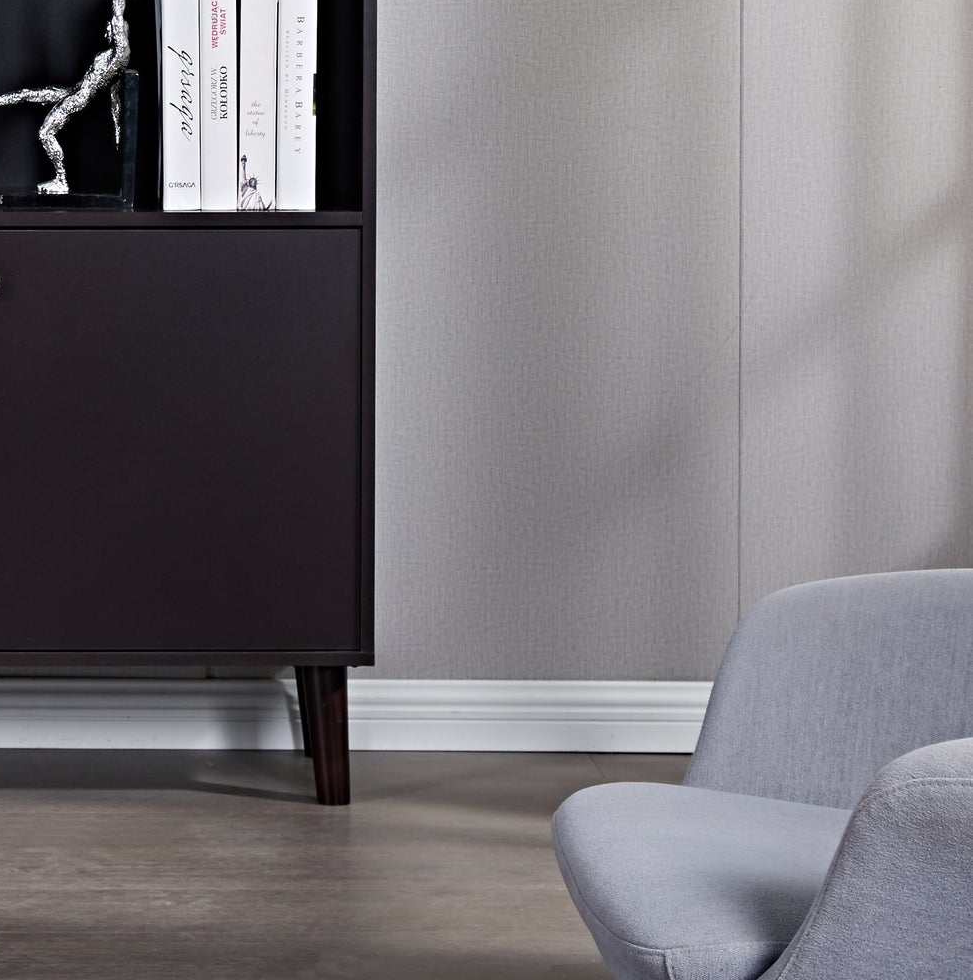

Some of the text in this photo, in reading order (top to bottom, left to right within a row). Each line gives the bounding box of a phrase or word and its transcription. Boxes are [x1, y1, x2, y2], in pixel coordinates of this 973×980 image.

[220, 66, 228, 119] KOŁODKO
[252, 118, 259, 126] of
[245, 129, 265, 138] liberty
